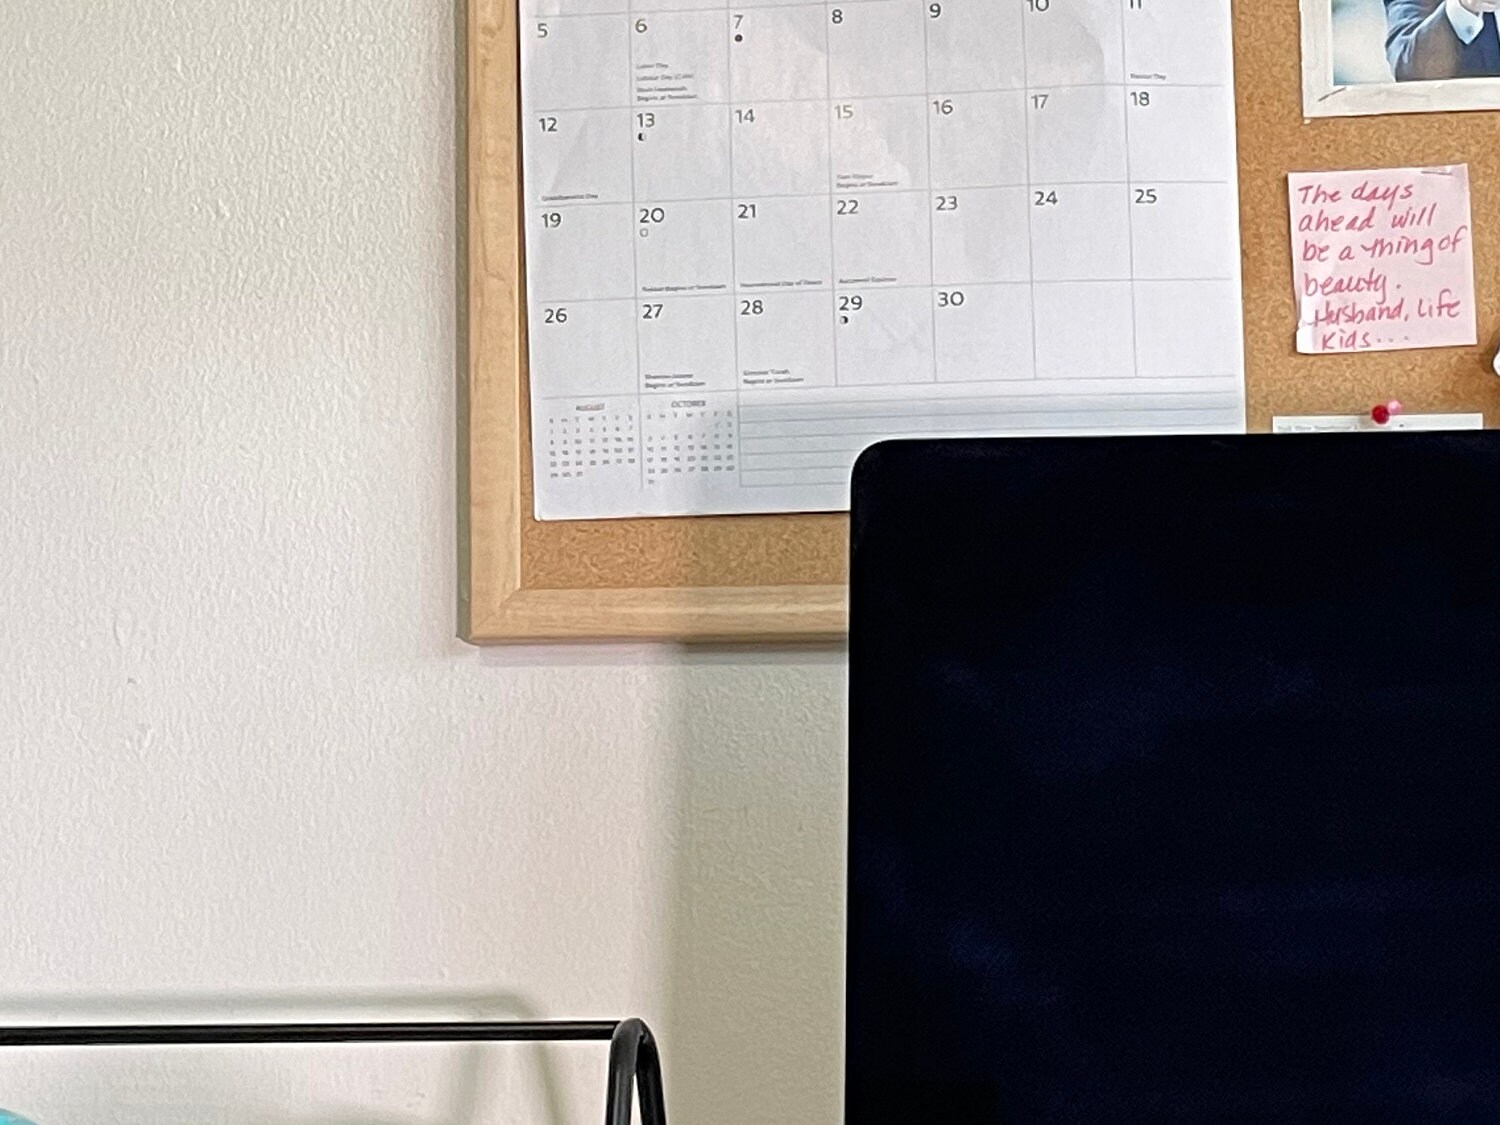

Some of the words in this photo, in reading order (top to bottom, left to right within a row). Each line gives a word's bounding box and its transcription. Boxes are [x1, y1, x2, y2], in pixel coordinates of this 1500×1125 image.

[929, 3, 941, 18] 9
[1029, 0, 1050, 12] 10
[734, 15, 744, 29] 7
[832, 10, 843, 24] 8
[537, 24, 548, 38] 5
[635, 19, 648, 32] 6
[1031, 95, 1049, 110] 17
[1130, 92, 1150, 106] 18
[834, 105, 853, 120] 15
[932, 100, 953, 115] 16
[637, 113, 655, 128] 13
[735, 109, 755, 124] 14
[539, 117, 557, 132] 12
[936, 196, 958, 211] 23
[1034, 191, 1058, 206] 24
[1135, 189, 1157, 204] 25
[1298, 184, 1342, 205] The
[1351, 181, 1414, 211] days
[737, 204, 757, 219] 21
[836, 200, 858, 215] 22
[541, 213, 561, 228] 19
[639, 208, 665, 223] 20
[1298, 206, 1376, 232] ahead
[1391, 203, 1437, 229] will
[1303, 240, 1331, 262] be
[1338, 246, 1355, 261] a
[1361, 235, 1434, 266] thing
[1437, 226, 1468, 252] of
[839, 296, 863, 311] 29
[937, 291, 964, 307] 30
[642, 304, 663, 319] 27
[740, 300, 763, 315] 28
[544, 308, 567, 324] 26
